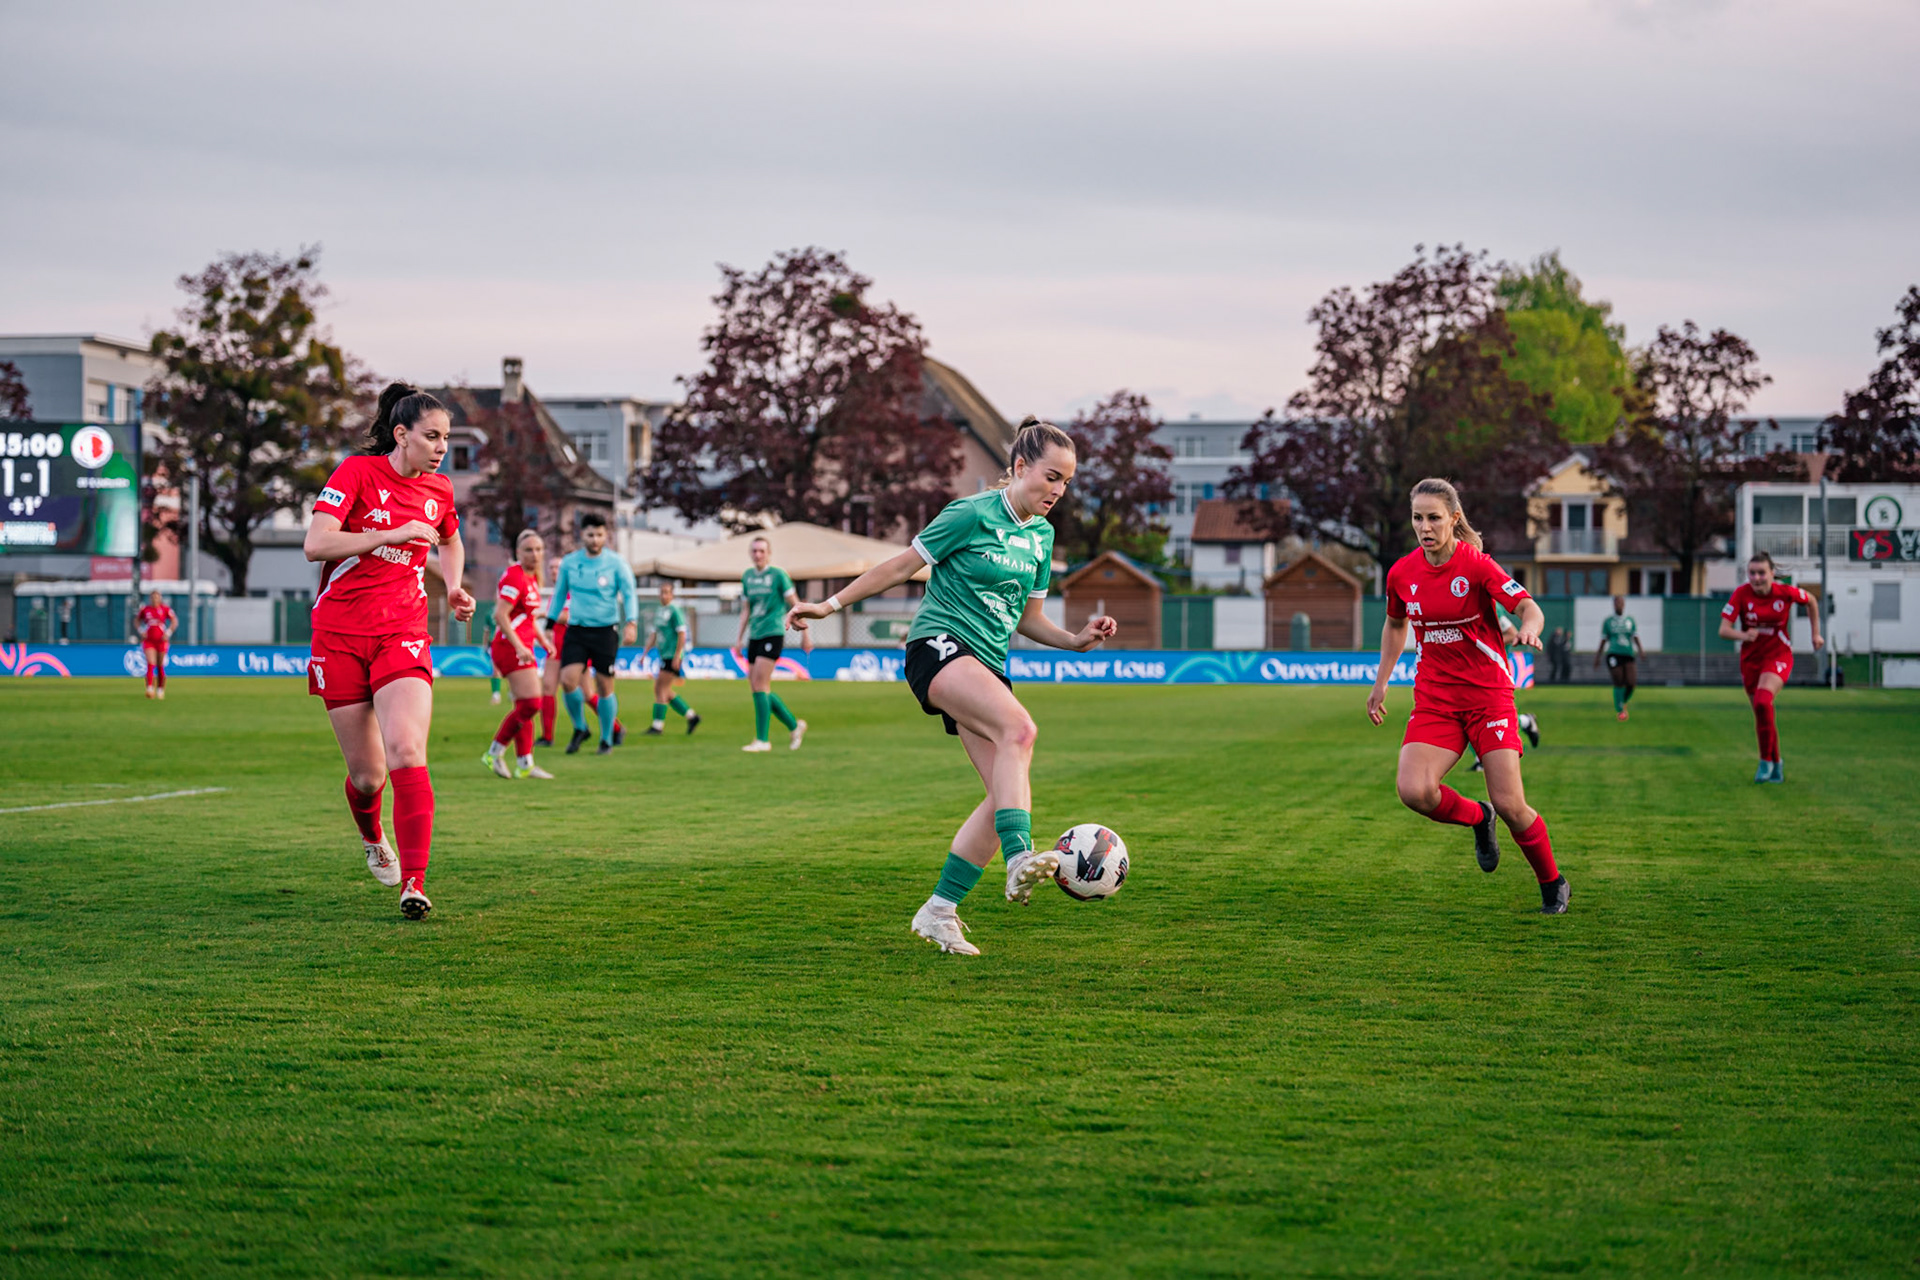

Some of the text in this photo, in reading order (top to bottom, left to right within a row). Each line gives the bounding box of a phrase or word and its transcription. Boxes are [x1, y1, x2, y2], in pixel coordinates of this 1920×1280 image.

[363, 508, 392, 525] AXA
[238, 652, 269, 673] Un
[1010, 657, 1166, 683] lieu pour tous
[1260, 658, 1380, 681] Ouverture
